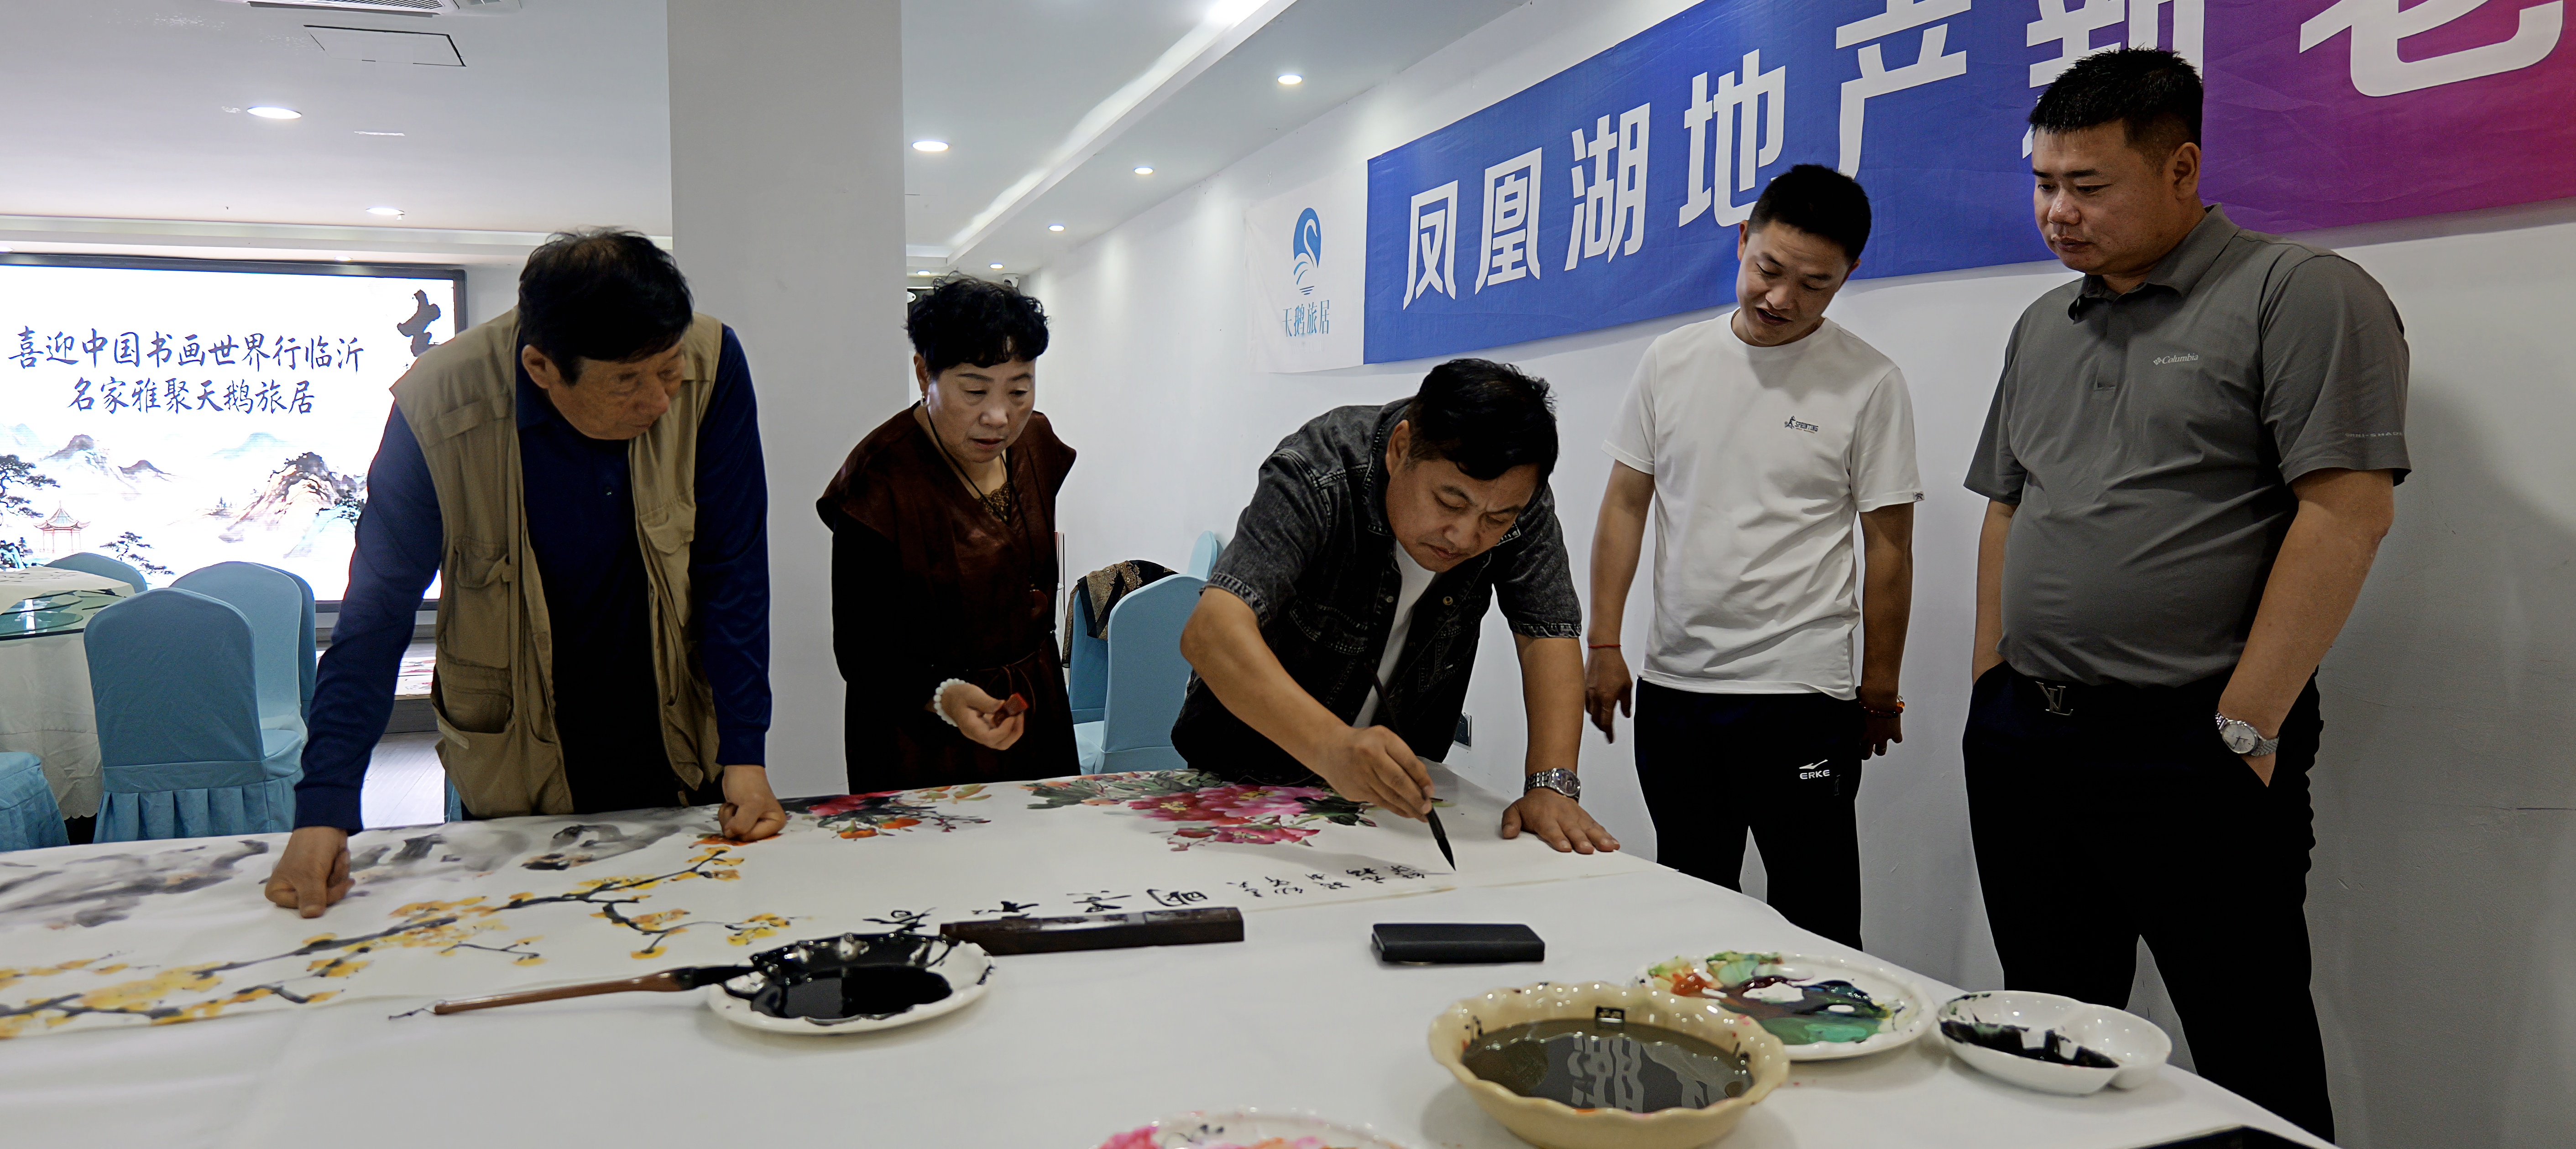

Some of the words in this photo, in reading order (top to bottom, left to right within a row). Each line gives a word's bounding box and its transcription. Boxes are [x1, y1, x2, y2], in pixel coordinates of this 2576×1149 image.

[1282, 299, 1330, 337] 天鹅旅居
[8, 325, 365, 374] 喜迎中国书画世界行临沂
[2162, 353, 2199, 364] Columbia
[67, 376, 316, 414] 名家雅聚天鹅旅居
[1799, 769, 1830, 779] ERKE
